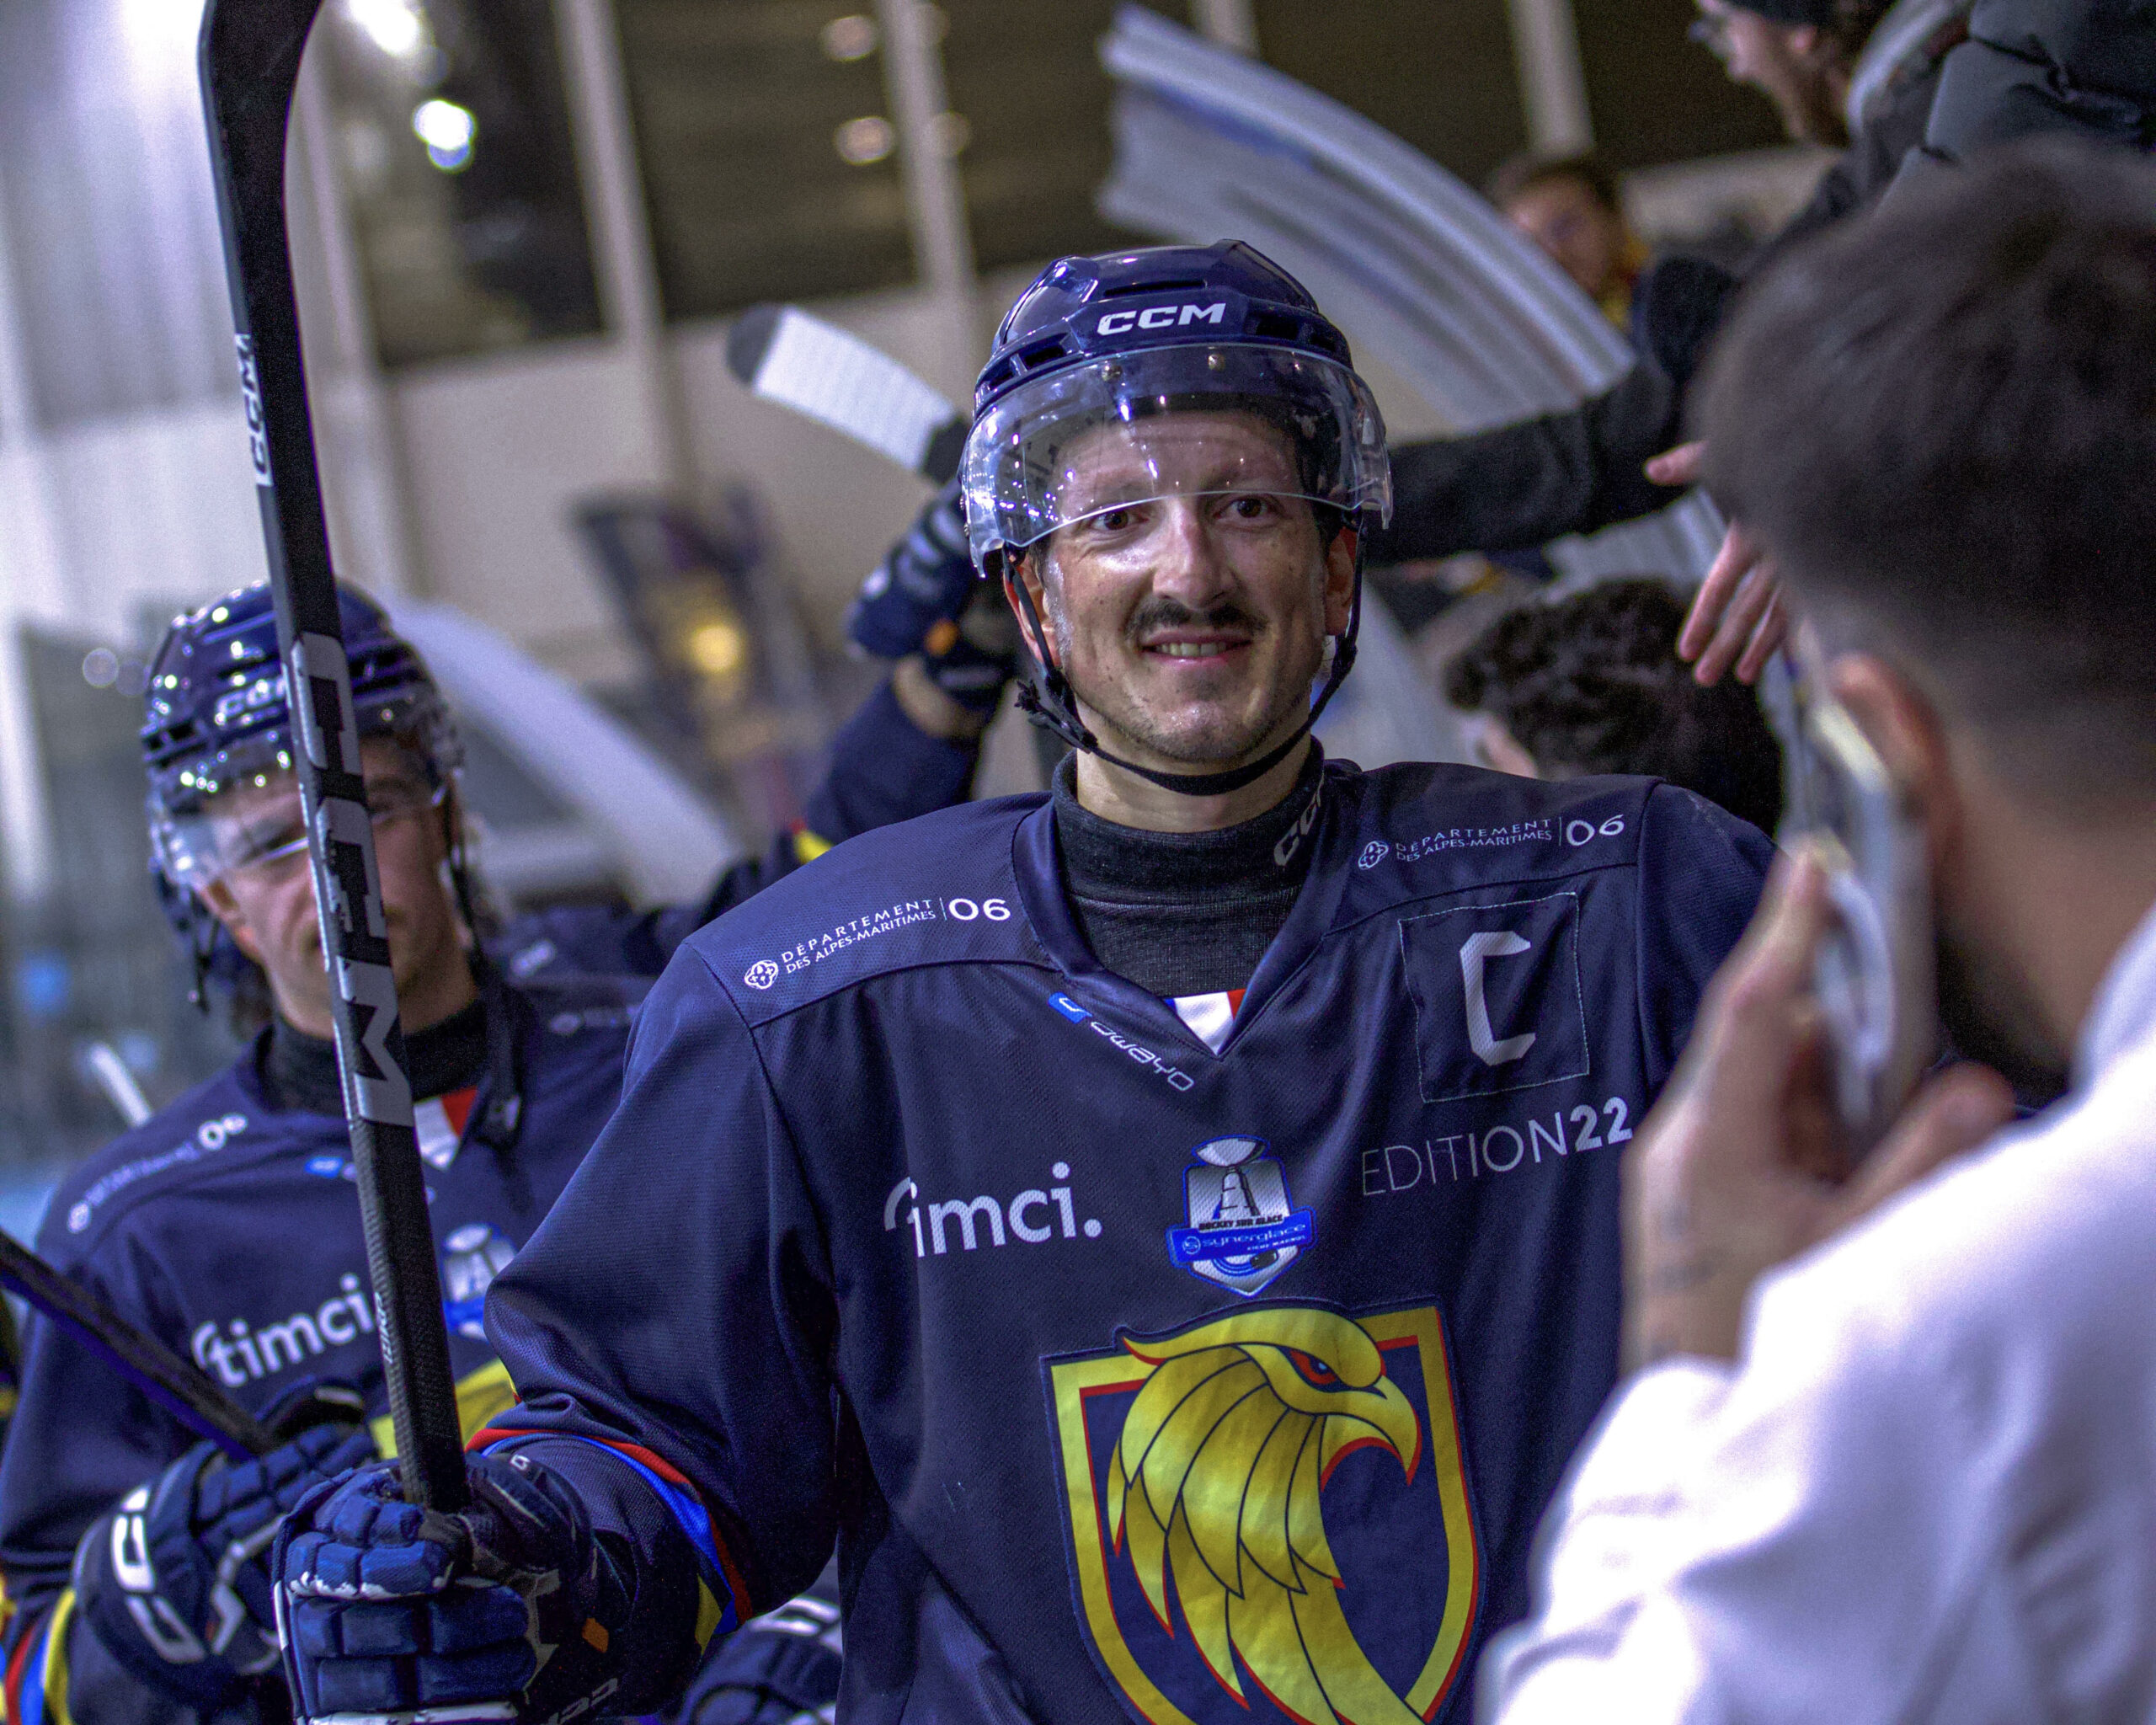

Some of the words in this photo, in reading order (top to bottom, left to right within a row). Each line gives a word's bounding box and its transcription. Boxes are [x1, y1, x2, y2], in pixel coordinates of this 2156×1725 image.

[1097, 302, 1226, 336] CCM
[234, 334, 274, 487] CCM
[1396, 852, 1421, 862] DES
[1423, 830, 1552, 856] ALPES-MARITIMES
[1566, 814, 1625, 846] 06
[291, 632, 414, 1128] CCM
[781, 899, 932, 964] DÉPARTEMENT
[947, 898, 1011, 921] 06
[786, 957, 812, 975] DES
[815, 910, 937, 963] ALPES-MARITIMES
[1460, 931, 1536, 1066] C
[885, 1162, 1102, 1258] imci.
[1198, 1220, 1233, 1231] HOCKEY
[1236, 1218, 1253, 1227] SUR
[1255, 1215, 1283, 1226] GLACE
[1202, 1224, 1306, 1247] synerglace
[110, 1486, 207, 1664] CC
